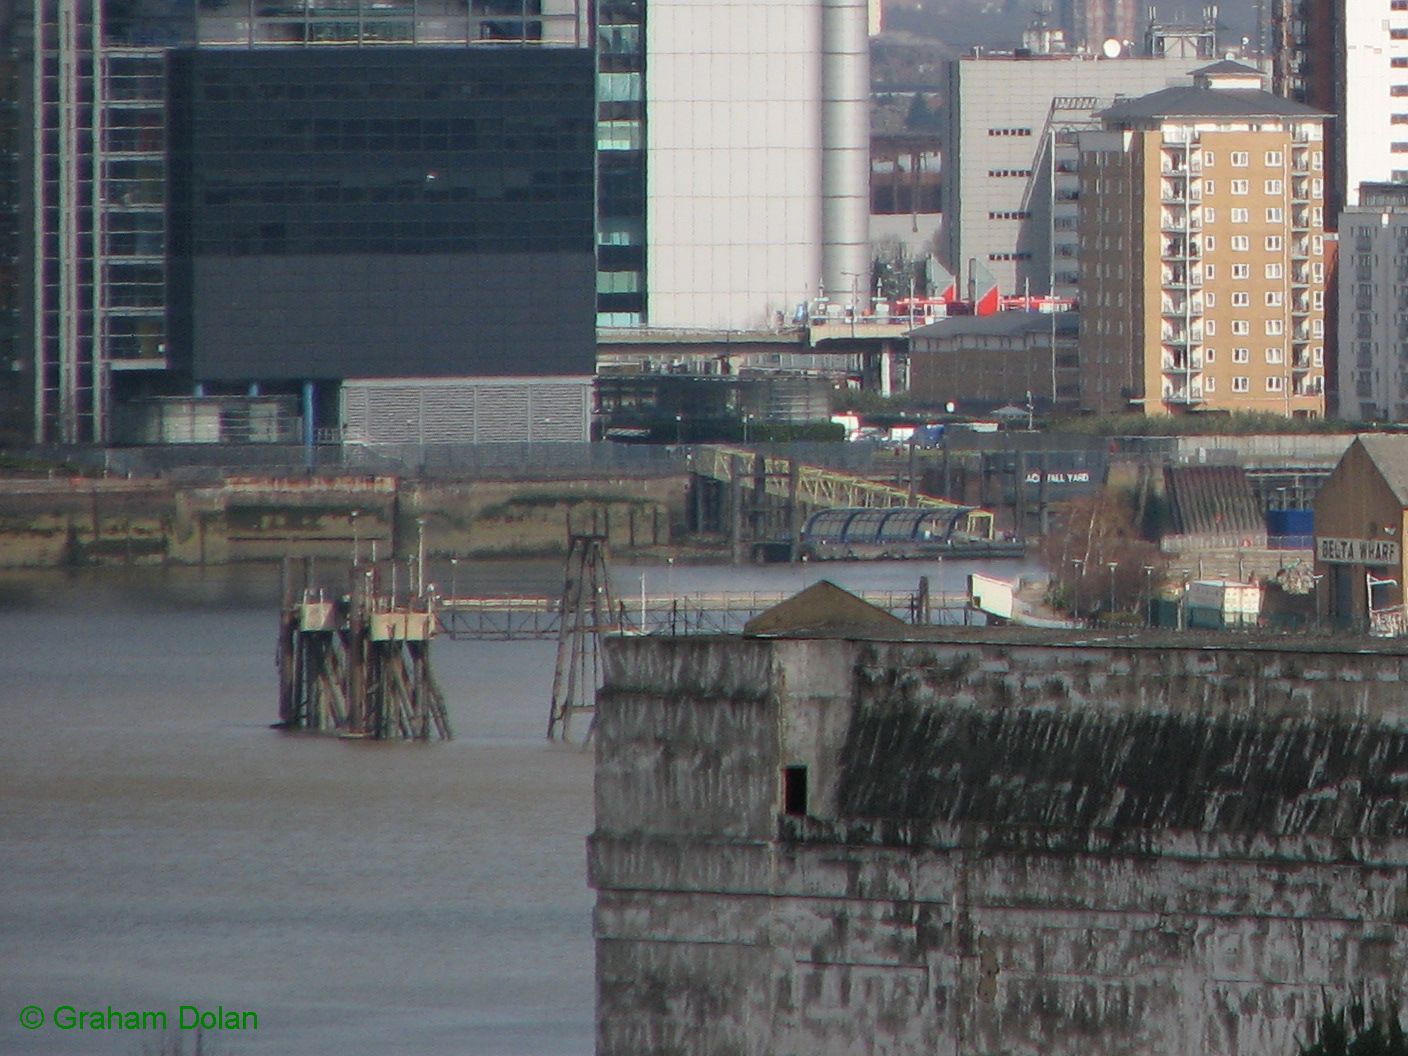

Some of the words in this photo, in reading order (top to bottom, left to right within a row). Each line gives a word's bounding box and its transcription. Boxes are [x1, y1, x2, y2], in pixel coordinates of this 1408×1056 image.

[1067, 472, 1089, 483] YARD
[1322, 540, 1354, 560] DELTA
[1360, 541, 1394, 561] WHARF
